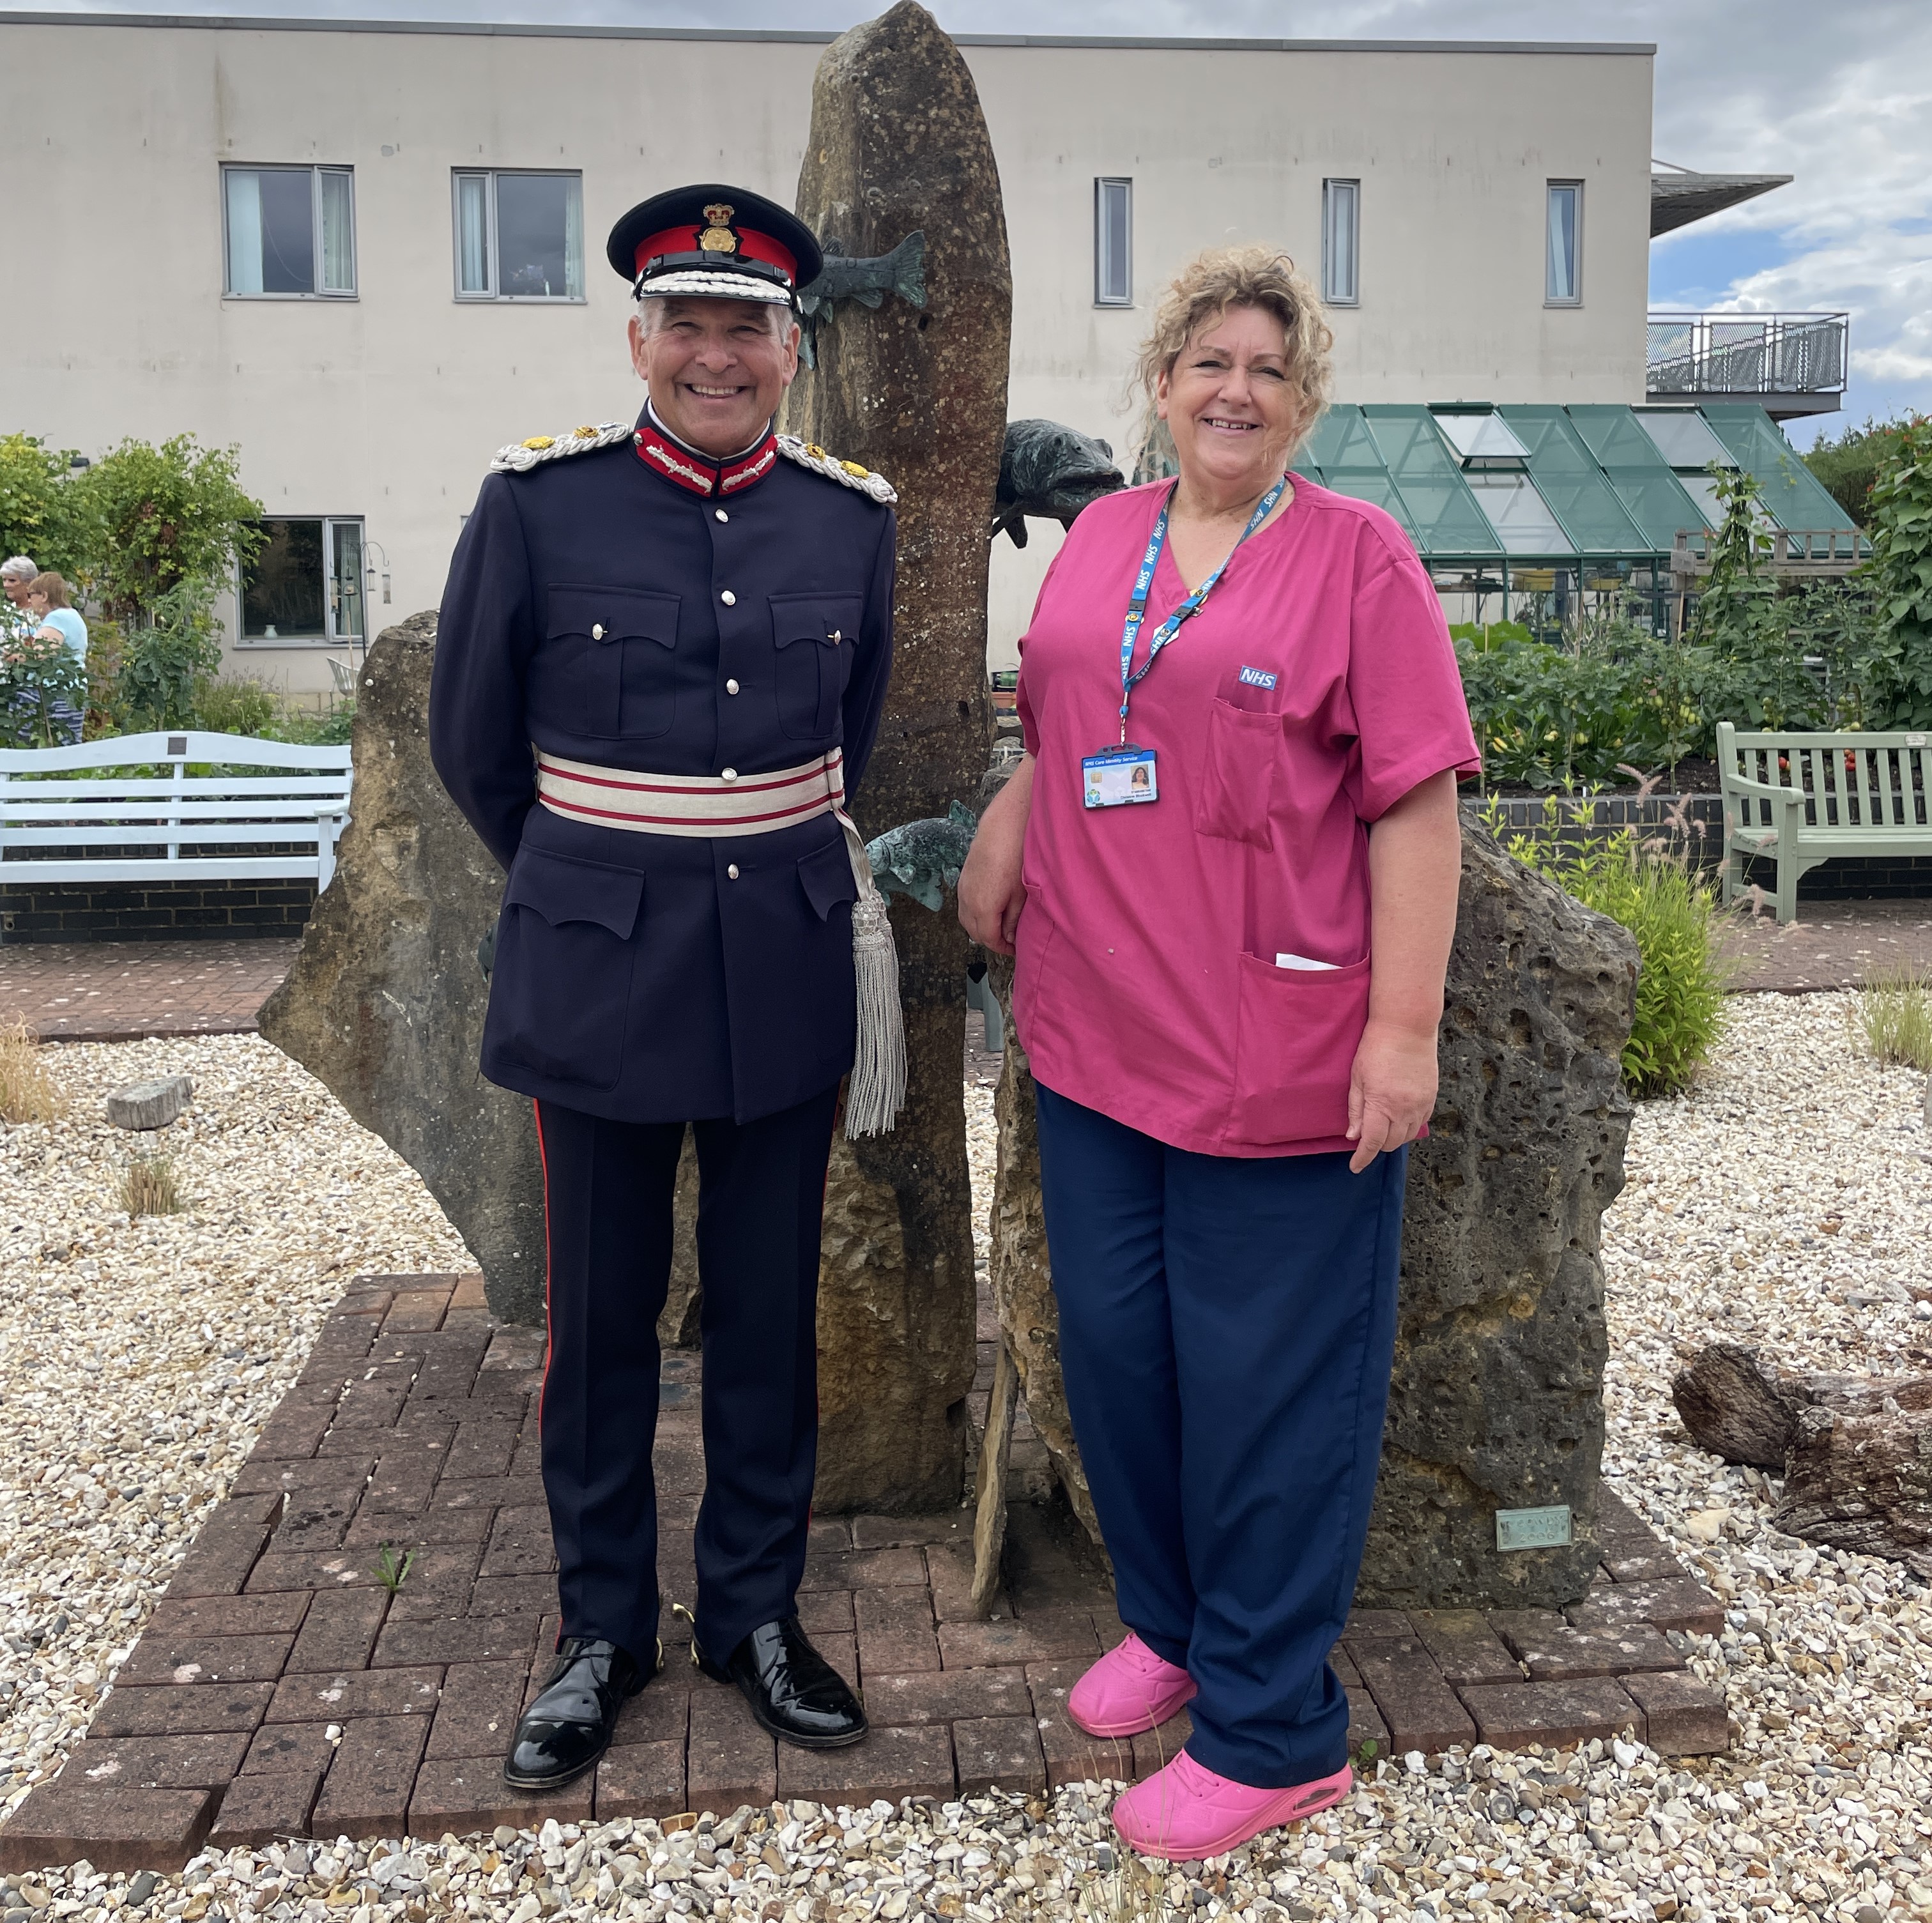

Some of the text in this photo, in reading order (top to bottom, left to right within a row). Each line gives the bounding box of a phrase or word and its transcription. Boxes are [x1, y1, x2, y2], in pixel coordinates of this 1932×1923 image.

[1264, 491, 1278, 507] NHS
[1153, 519, 1165, 540] NHS
[1250, 509, 1264, 530] NHS
[1144, 544, 1158, 565] NHS
[1135, 569, 1150, 590] NHS
[1124, 625, 1136, 647] NHS
[1241, 668, 1275, 687] NHS
